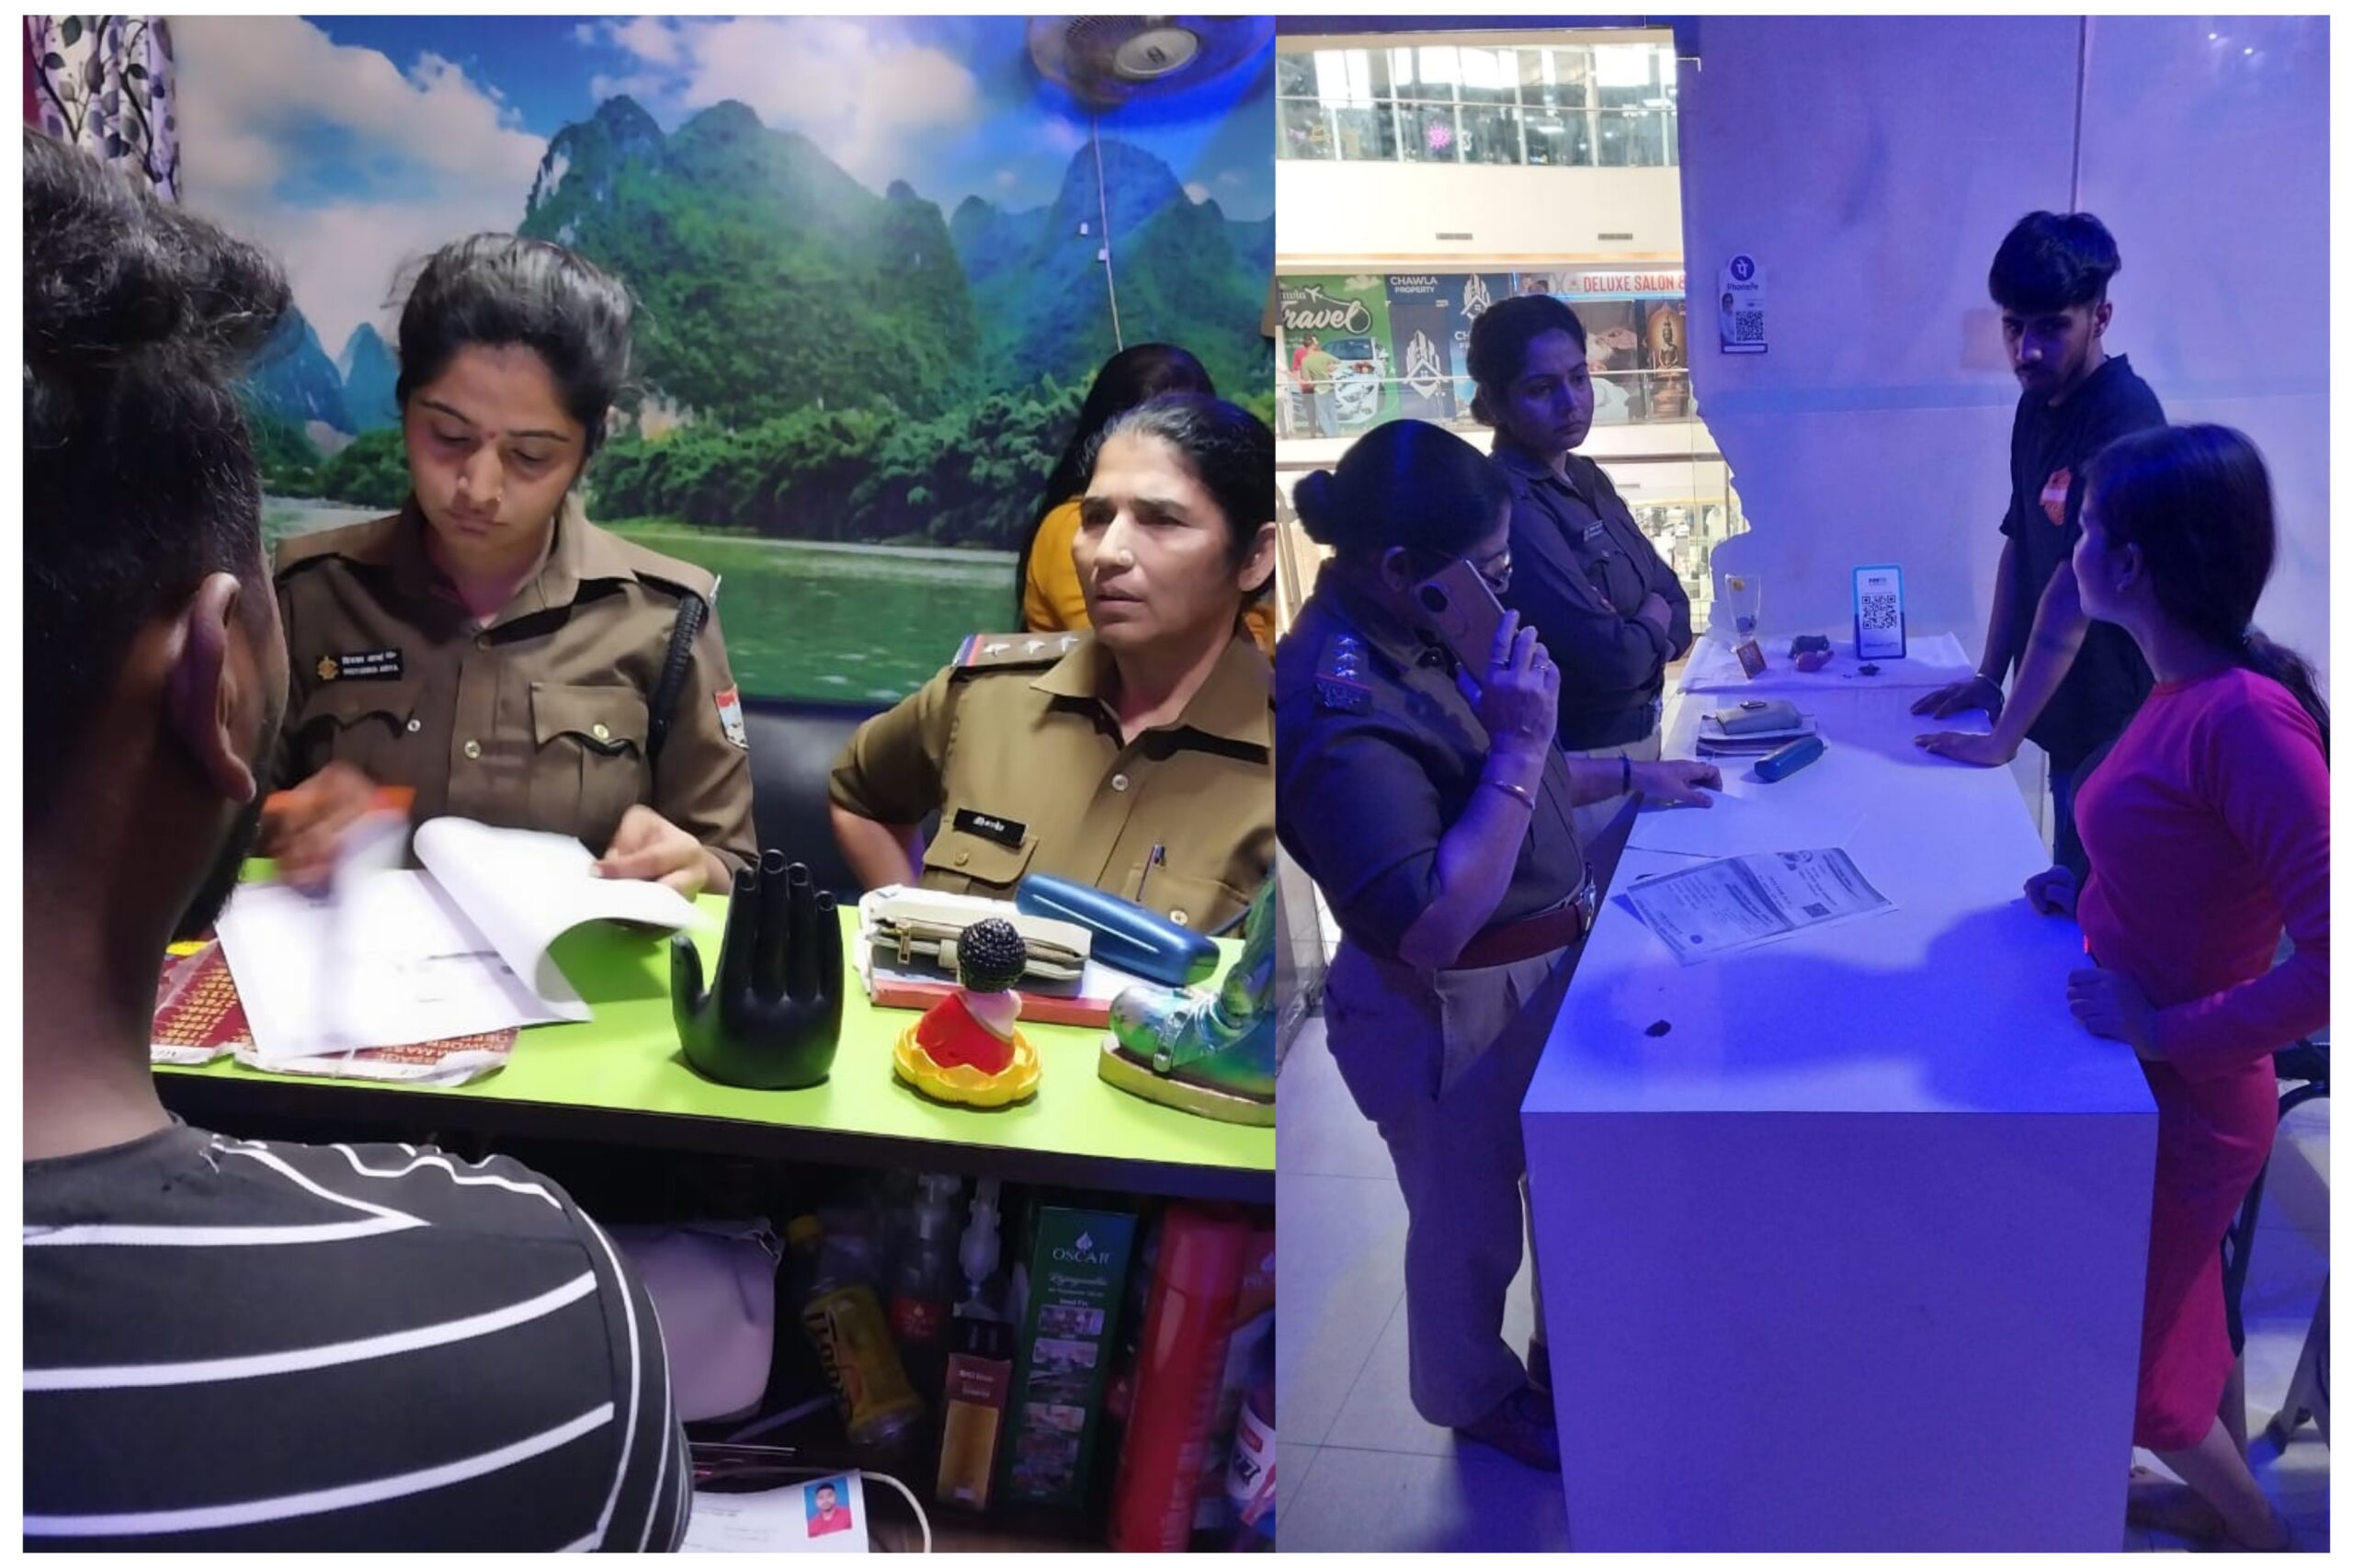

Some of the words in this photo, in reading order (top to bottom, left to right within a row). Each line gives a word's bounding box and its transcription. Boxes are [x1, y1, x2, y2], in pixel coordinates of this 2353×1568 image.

[1390, 276, 1438, 286] CHAWLA
[1584, 277, 1631, 292] DELUXE
[1634, 276, 1675, 291] SALON
